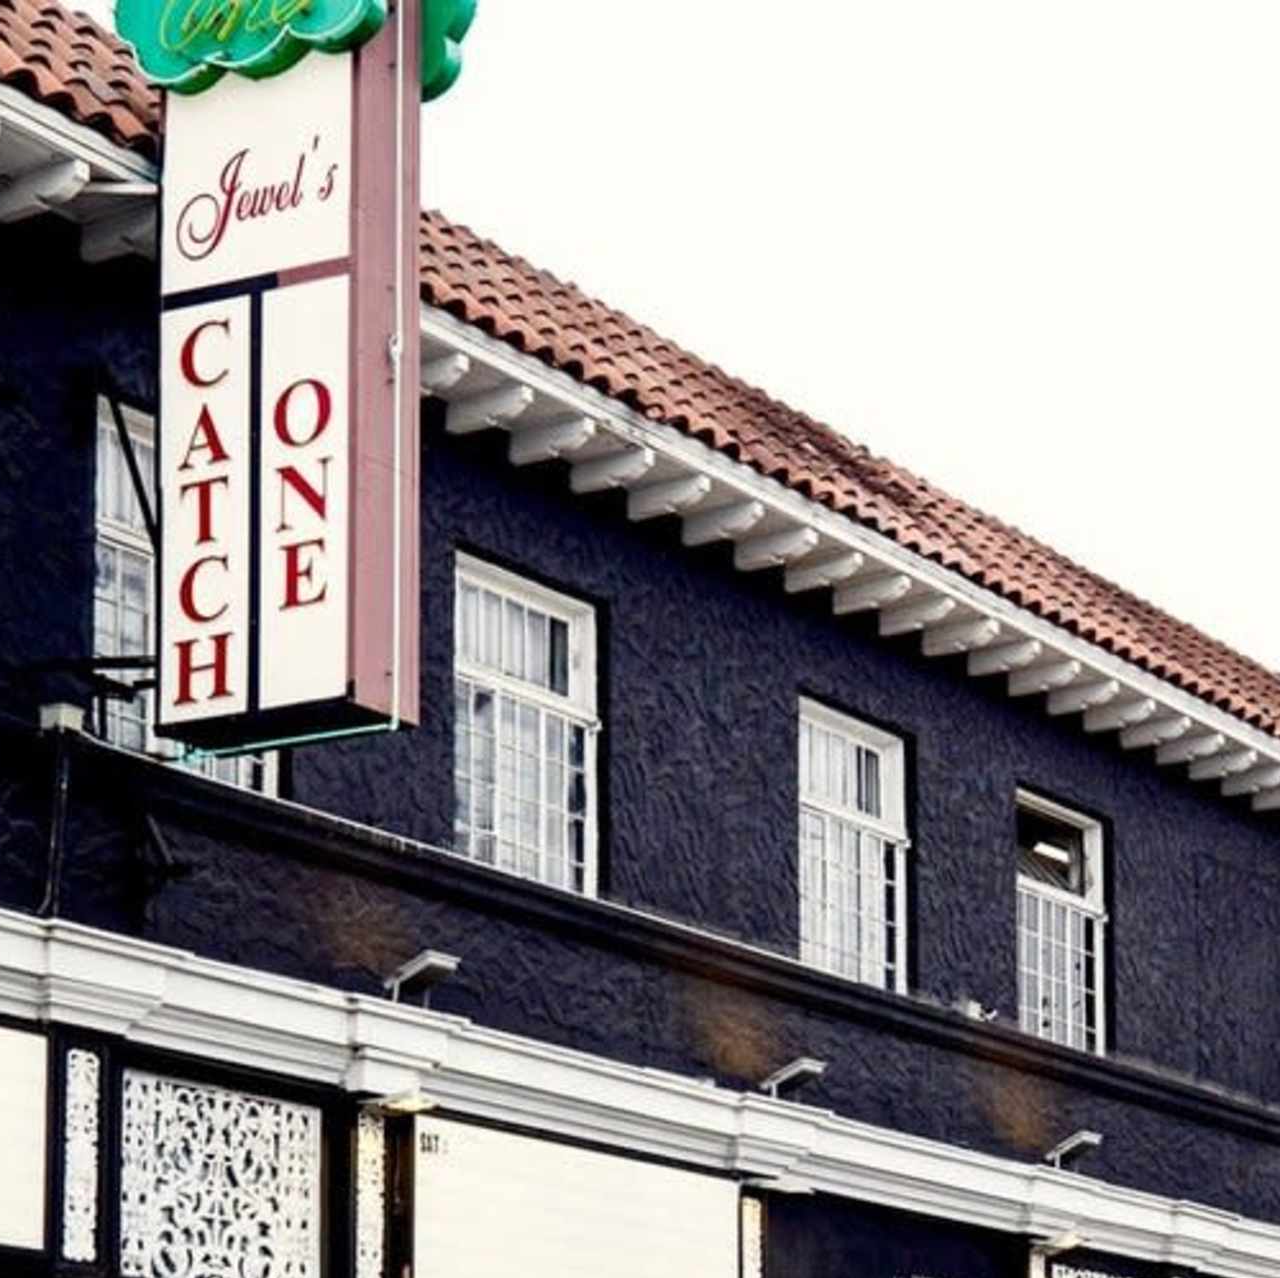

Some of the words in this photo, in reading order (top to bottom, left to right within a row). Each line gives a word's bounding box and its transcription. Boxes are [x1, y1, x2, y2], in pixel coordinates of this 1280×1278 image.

[176, 136, 339, 261] Jewel's
[173, 319, 234, 707] CATCH
[272, 378, 333, 612] ONE
